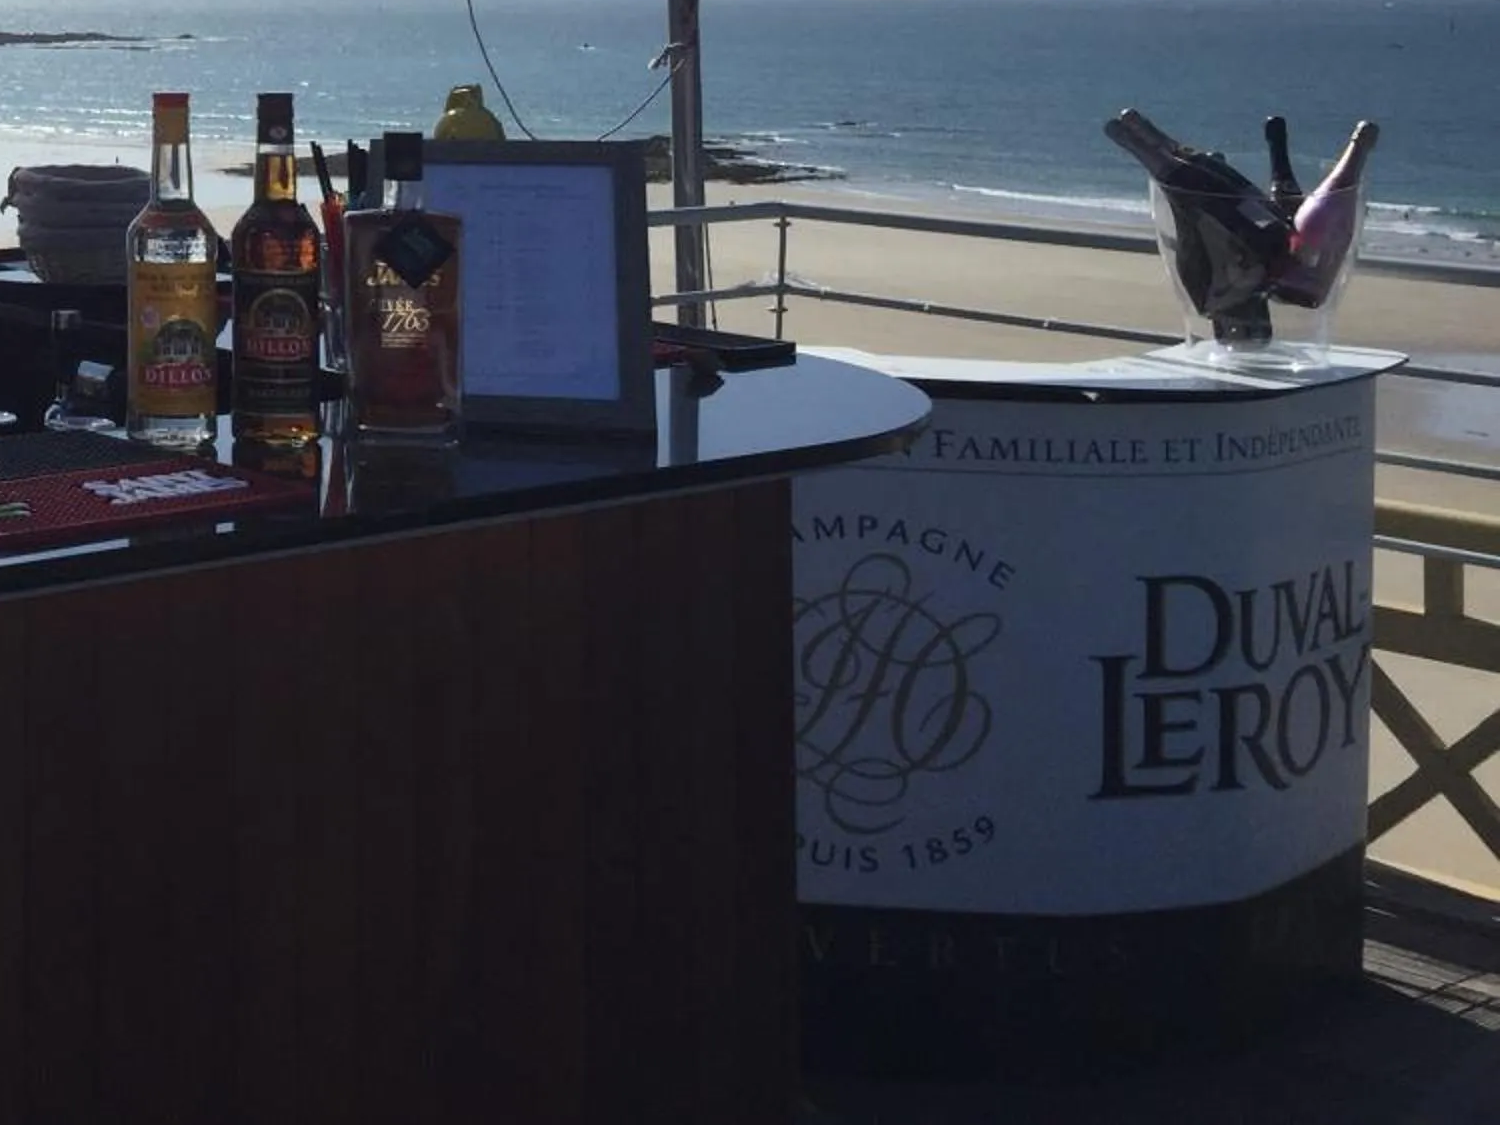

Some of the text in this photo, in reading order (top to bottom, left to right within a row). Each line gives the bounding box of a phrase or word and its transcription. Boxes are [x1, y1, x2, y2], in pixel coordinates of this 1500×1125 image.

[931, 429, 1148, 464] FAMILIALE
[1162, 438, 1199, 463] ET
[1088, 642, 1369, 800] LEROY
[902, 815, 994, 870] 1859
